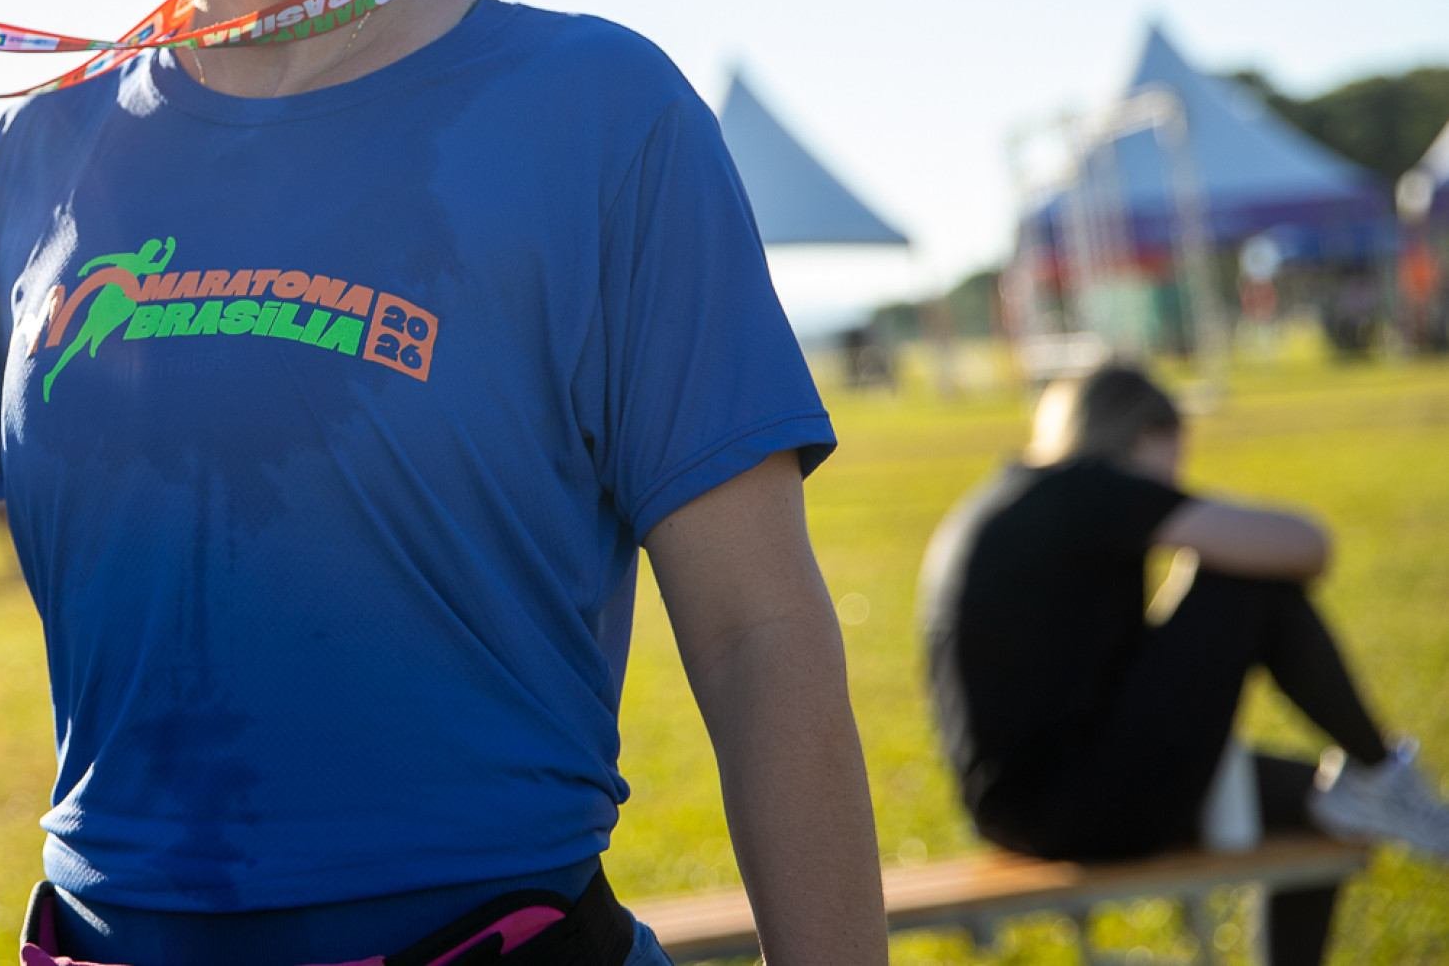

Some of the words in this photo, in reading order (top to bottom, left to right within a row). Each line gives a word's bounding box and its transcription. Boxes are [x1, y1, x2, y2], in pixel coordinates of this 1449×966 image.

[138, 269, 374, 316] MARATONA
[381, 304, 429, 341] 20
[374, 333, 423, 370] 26
